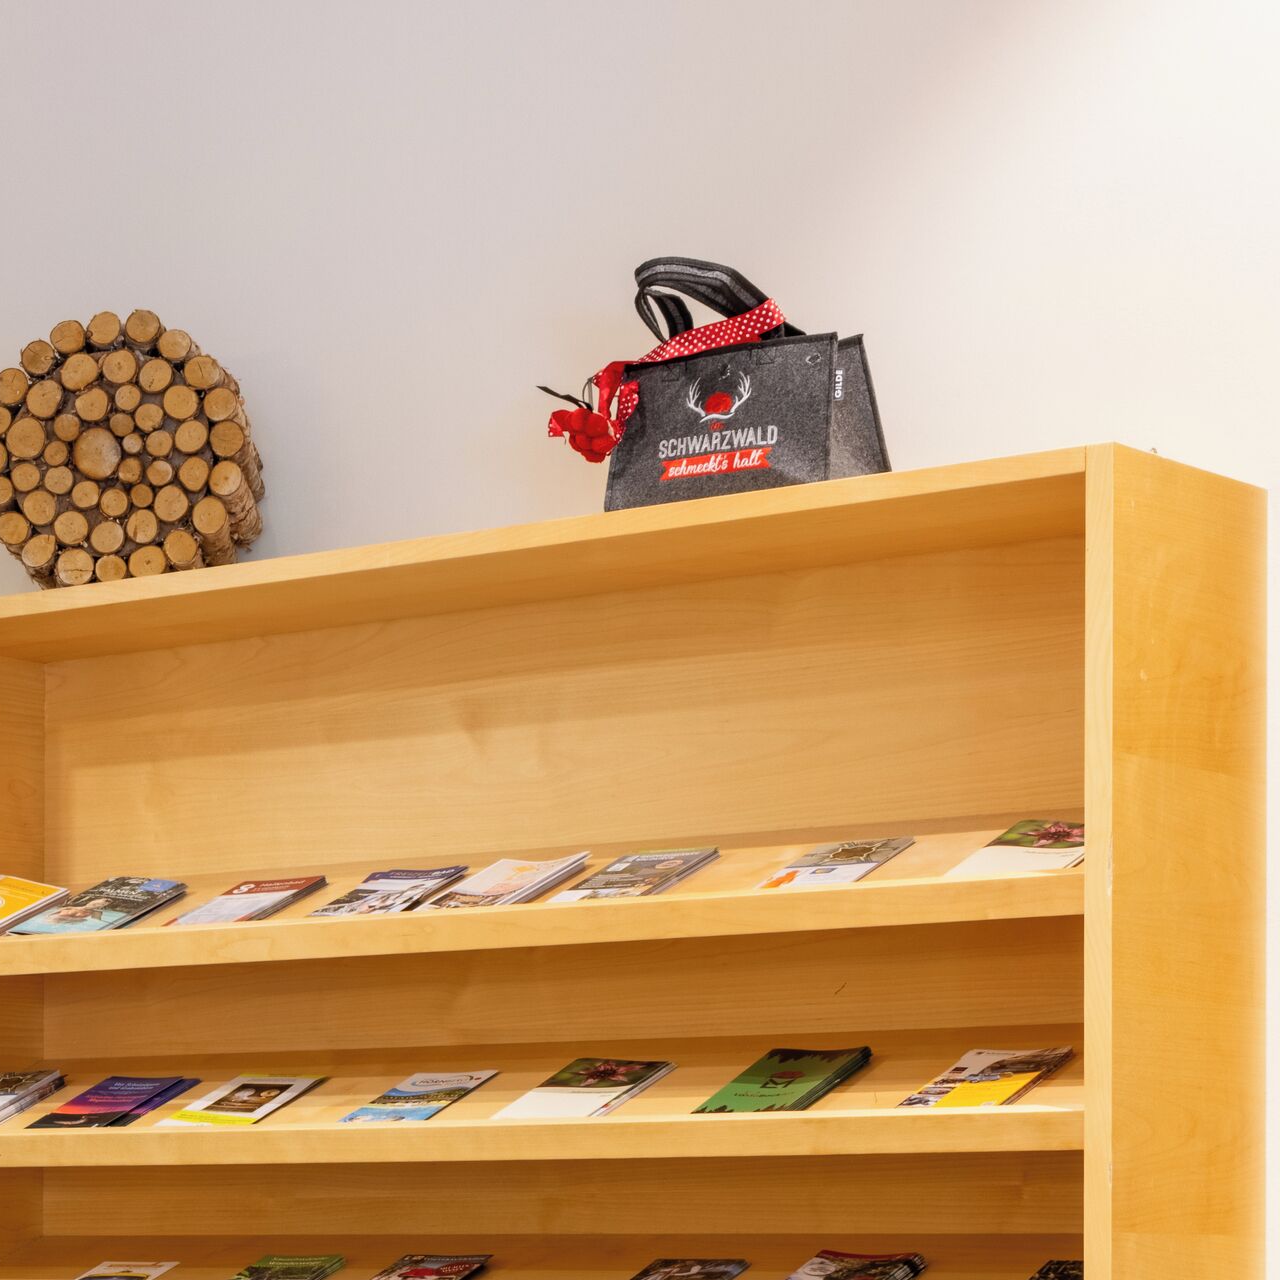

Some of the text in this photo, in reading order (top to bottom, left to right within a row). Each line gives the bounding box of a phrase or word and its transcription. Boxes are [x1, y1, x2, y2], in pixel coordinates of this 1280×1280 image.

[834, 369, 843, 398] GILDE
[658, 425, 778, 459] SCHWARZWALD
[668, 449, 765, 477] schmeckt's halt
